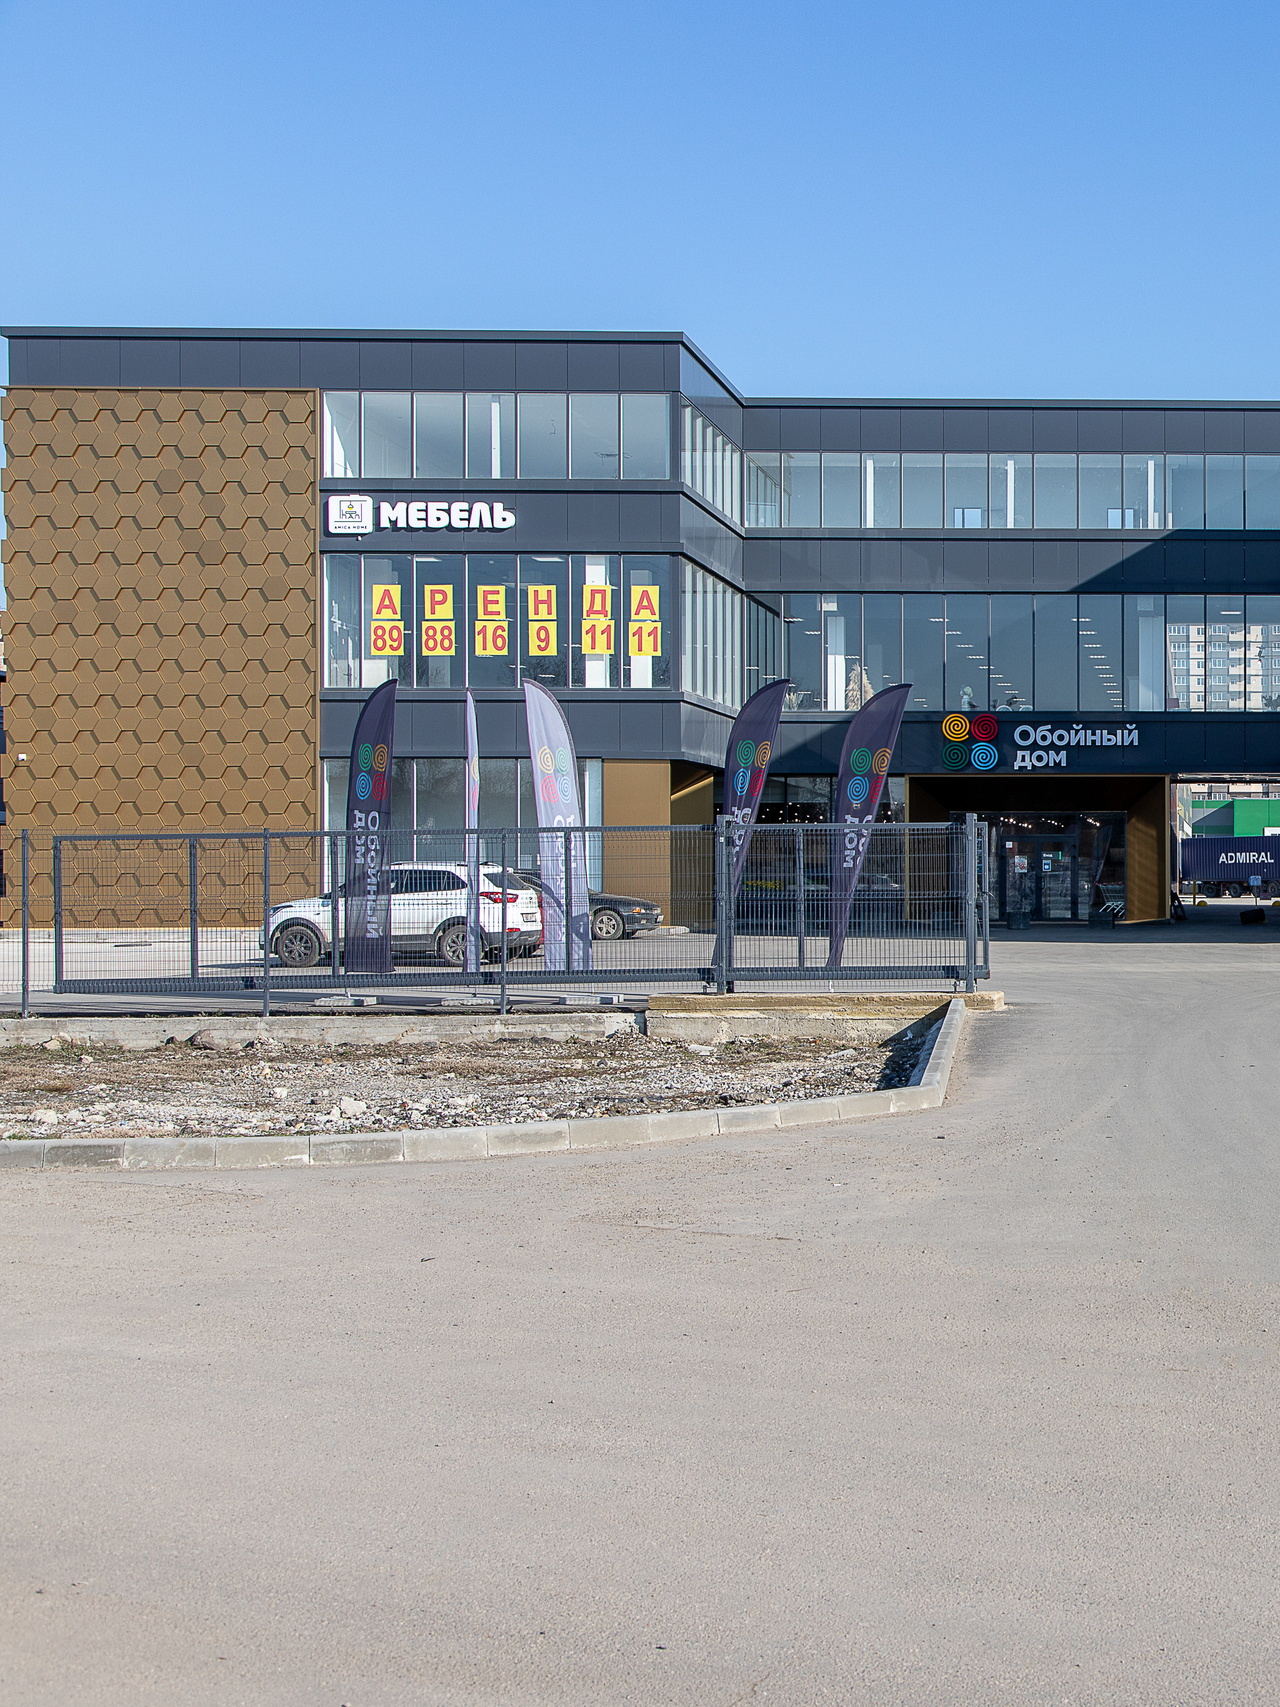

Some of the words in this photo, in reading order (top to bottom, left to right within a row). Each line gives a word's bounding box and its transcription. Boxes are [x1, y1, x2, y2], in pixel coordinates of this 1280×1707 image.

[379, 501, 516, 529] МЕБЕЛЬ
[372, 625, 403, 651] 89
[424, 625, 453, 651] 88
[476, 624, 507, 651] 16
[536, 625, 550, 651] 9
[585, 622, 612, 650] 11
[632, 626, 659, 652] 11
[1014, 724, 1139, 747] Обойный
[1218, 852, 1275, 864] ADMIRAL
